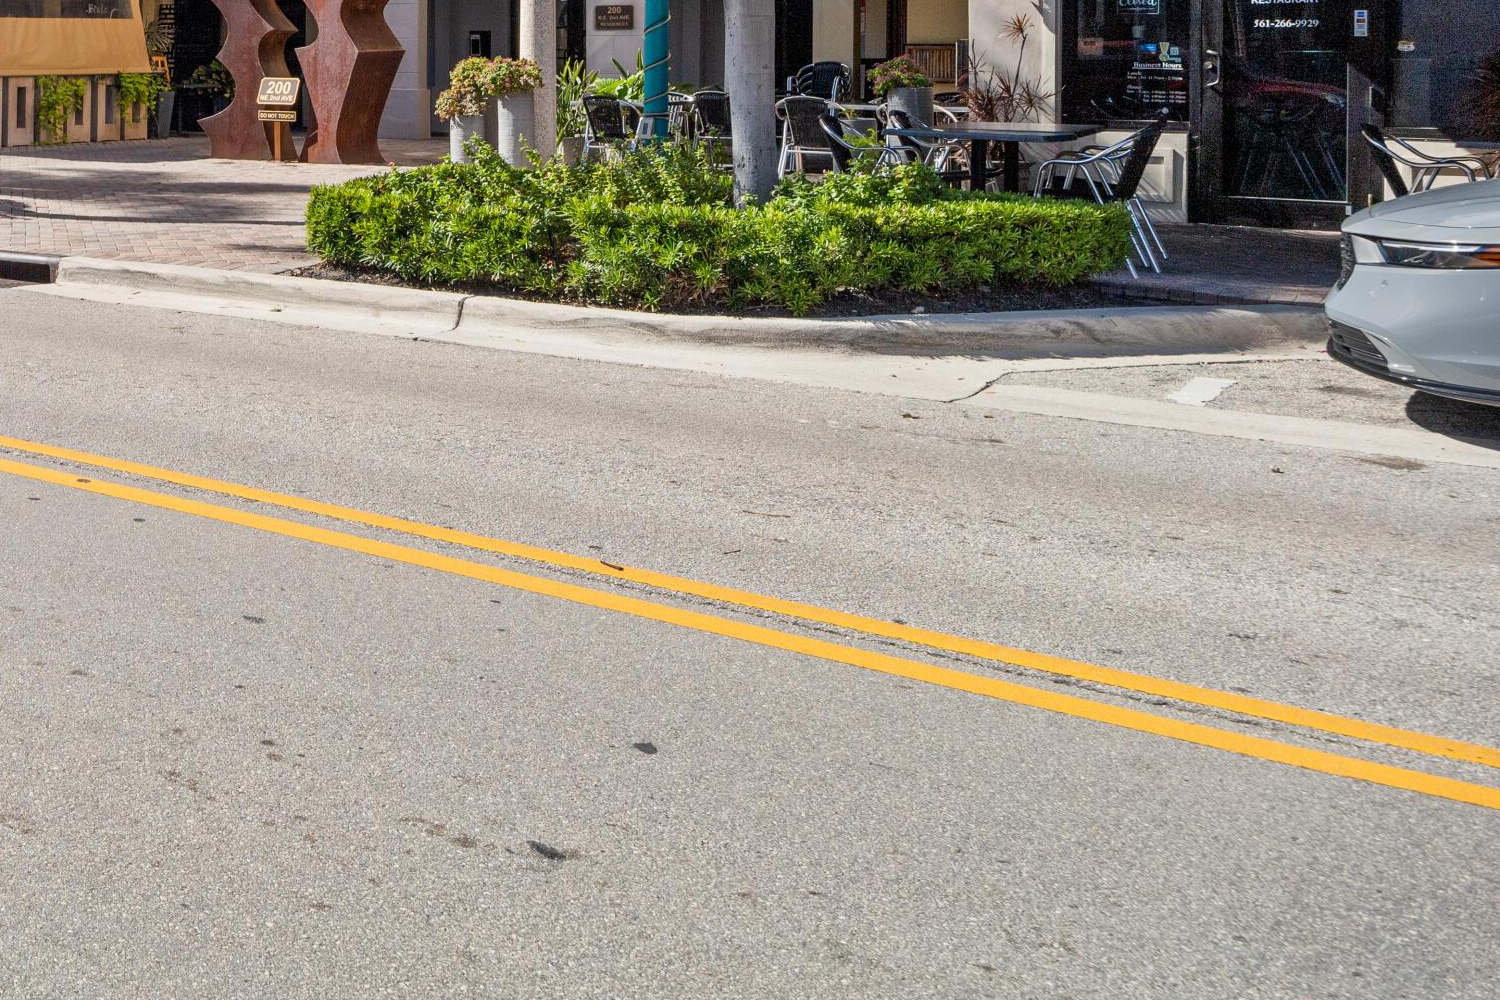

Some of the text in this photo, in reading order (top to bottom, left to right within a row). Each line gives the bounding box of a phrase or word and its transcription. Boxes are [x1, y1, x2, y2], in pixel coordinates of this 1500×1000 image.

[607, 6, 622, 14] 200
[1253, 19, 1319, 28] 561-266-9929
[266, 81, 292, 94] 200
